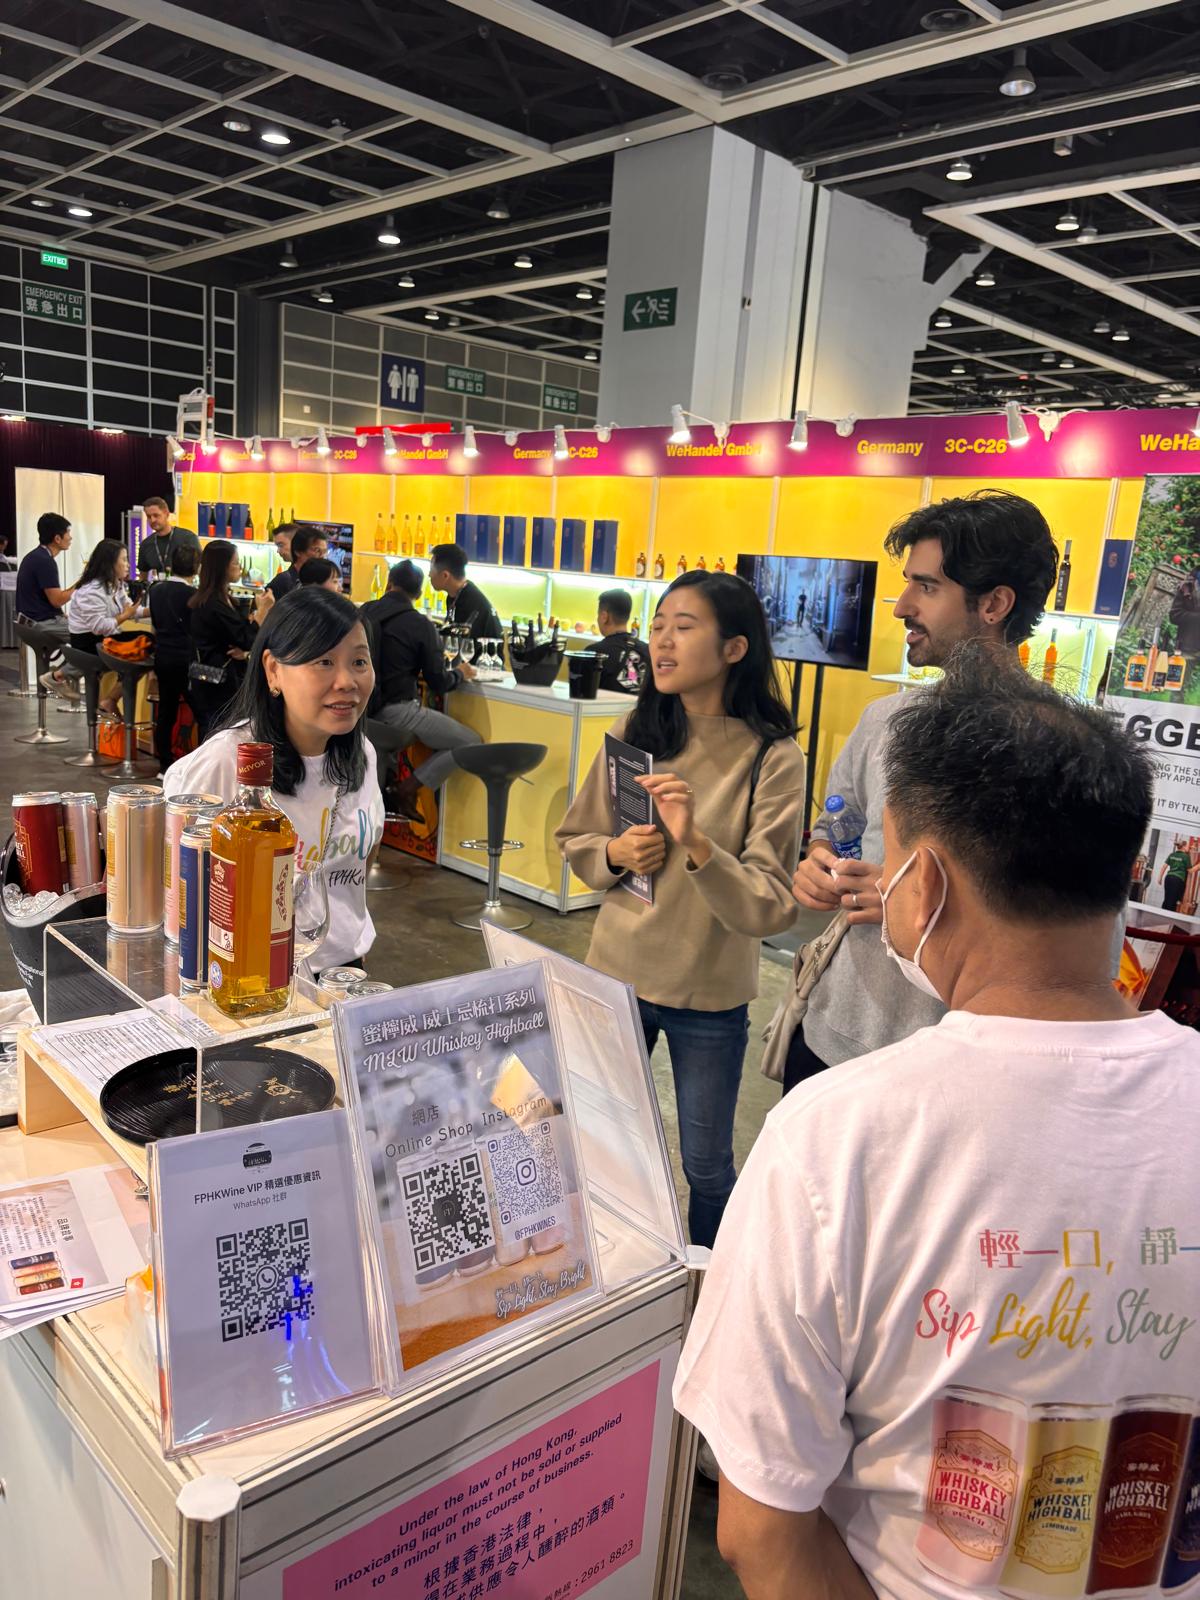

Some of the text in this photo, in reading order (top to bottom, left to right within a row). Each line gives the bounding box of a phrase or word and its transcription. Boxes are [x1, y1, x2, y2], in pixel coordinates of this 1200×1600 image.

[25, 286, 83, 304] EMERGENCY EXIT
[25, 297, 82, 320] 緊急出口
[569, 446, 598, 459] C-C26
[666, 444, 723, 457] WeHandel
[857, 438, 1007, 456] Germany 3C-C26
[238, 760, 266, 774] McIVOR
[1174, 765, 1190, 776] THE
[1157, 798, 1167, 808] IT
[1169, 800, 1180, 809] BY
[363, 1011, 545, 1073] MLW Whiskey Highball
[412, 1105, 440, 1126] 網店
[482, 1096, 547, 1127] Instagram
[385, 1122, 473, 1158] Online Shop
[194, 1170, 321, 1204] FPHKWine VIP 精選優惠資訊
[233, 1195, 271, 1210] WhatsApp
[514, 1215, 556, 1241] @FPHKWINES
[539, 1280, 557, 1297] Stay
[560, 1260, 585, 1290] Bright
[915, 1276, 1198, 1361] Sip Light, Stay
[400, 1428, 577, 1536] Under the law of Hong Kong,
[940, 1471, 1007, 1506] WHISKEY
[1109, 1480, 1170, 1499] WHISKEY
[334, 1412, 622, 1591] intoxicating liquor must not be sold or supplied
[935, 1487, 1006, 1521] HIGHBALL
[1034, 1493, 1092, 1509] WHISKEY
[1104, 1494, 1168, 1514] HIGHBALL
[372, 1449, 594, 1588] to a minor in the course of business.
[1028, 1506, 1091, 1523] HIGHBALL
[609, 1539, 634, 1564] 8823
